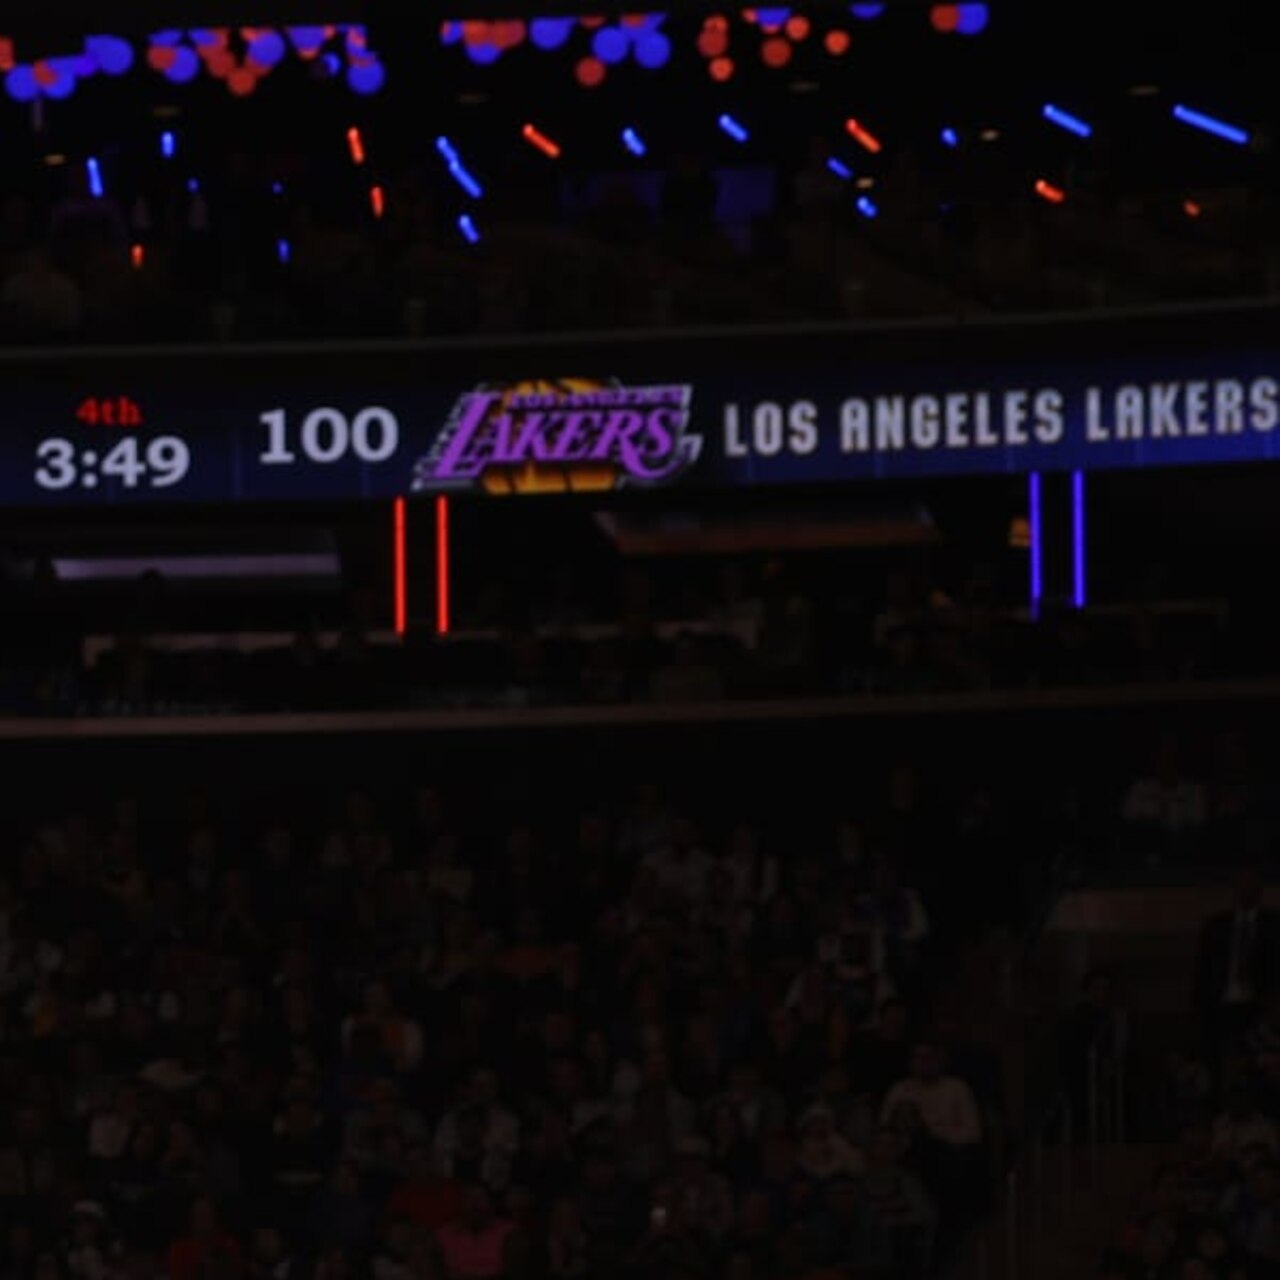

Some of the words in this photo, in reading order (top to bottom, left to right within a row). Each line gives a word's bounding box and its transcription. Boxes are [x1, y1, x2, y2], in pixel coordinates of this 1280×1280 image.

[76, 397, 142, 425] 4th
[259, 406, 399, 464] 100
[432, 393, 685, 480] LAKERS
[724, 402, 819, 456] LOS
[839, 390, 1064, 452] ANGELES
[1085, 378, 1279, 443] LAKERS
[35, 435, 190, 489] 3:49
